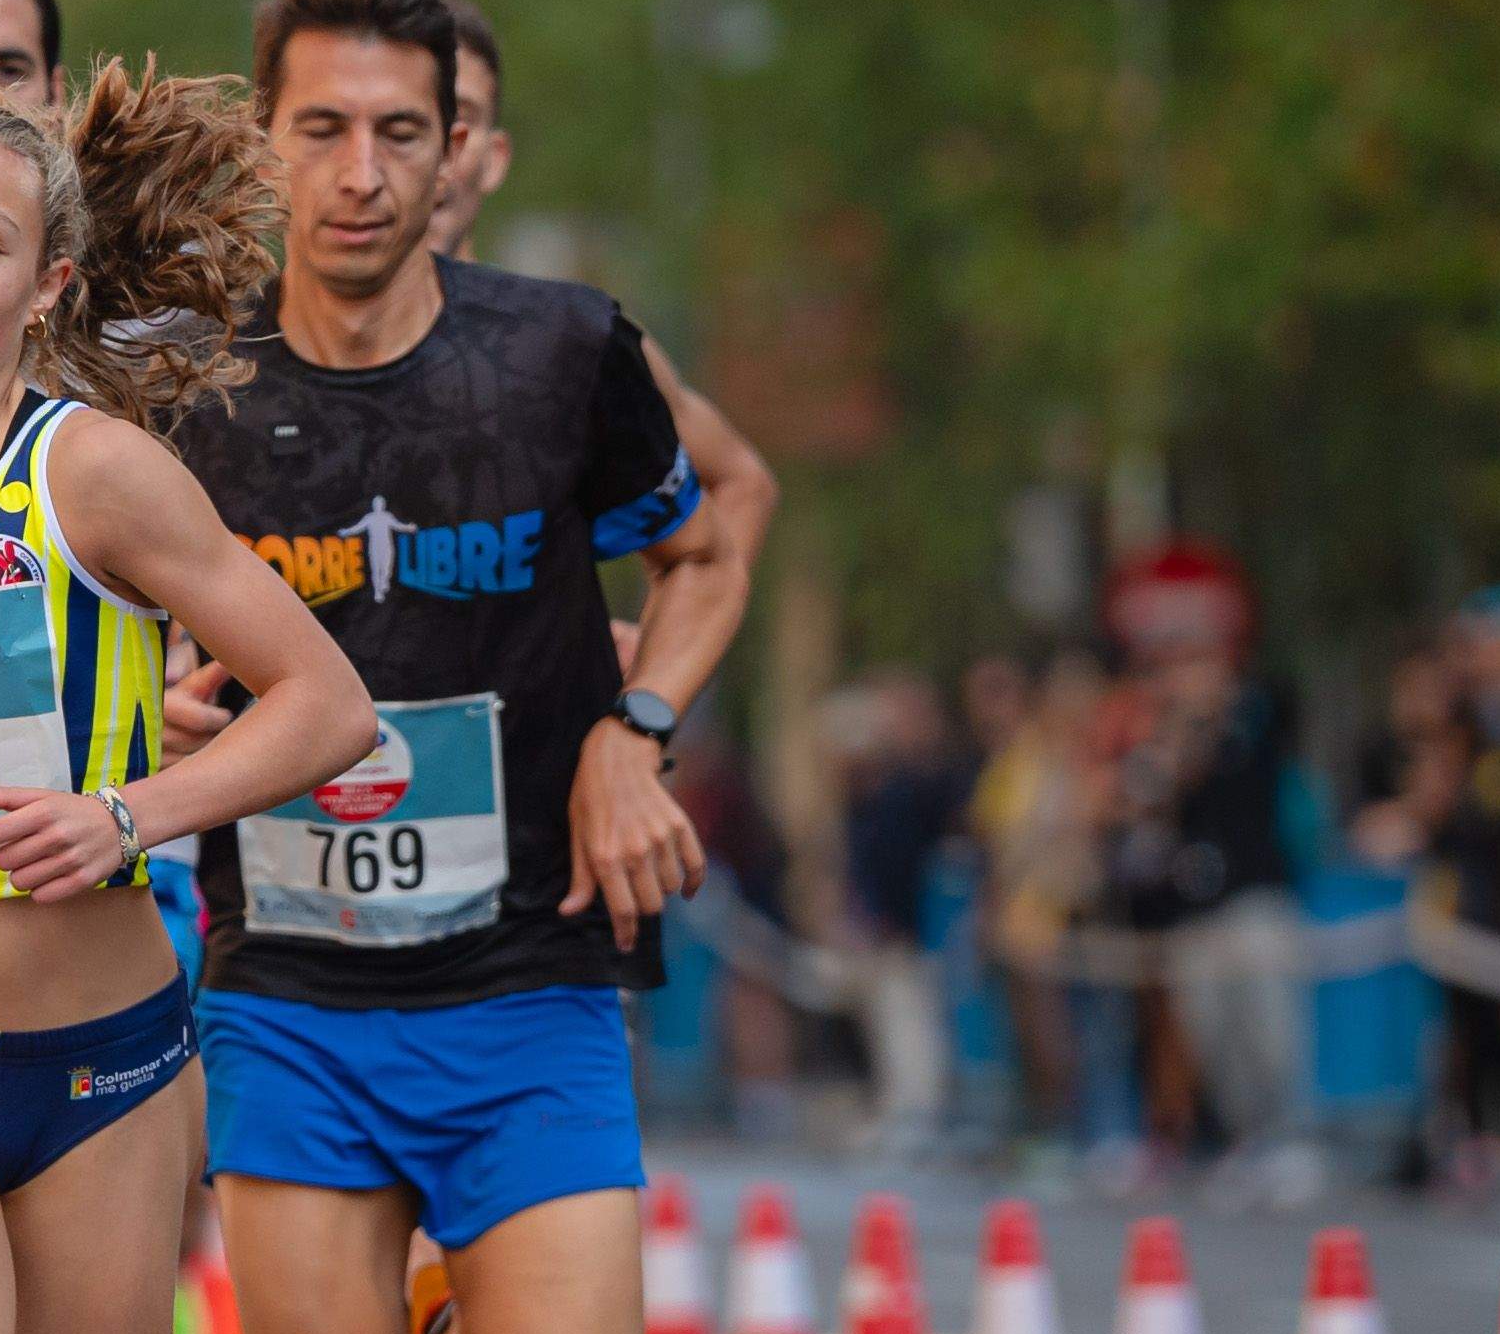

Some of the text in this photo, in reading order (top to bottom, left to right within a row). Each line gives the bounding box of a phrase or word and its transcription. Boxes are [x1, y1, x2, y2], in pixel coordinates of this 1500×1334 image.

[235, 510, 544, 600] ORRE LIBRE
[306, 825, 424, 893] 769
[95, 1058, 161, 1086] Colmenar
[96, 1072, 155, 1096] me gusta
